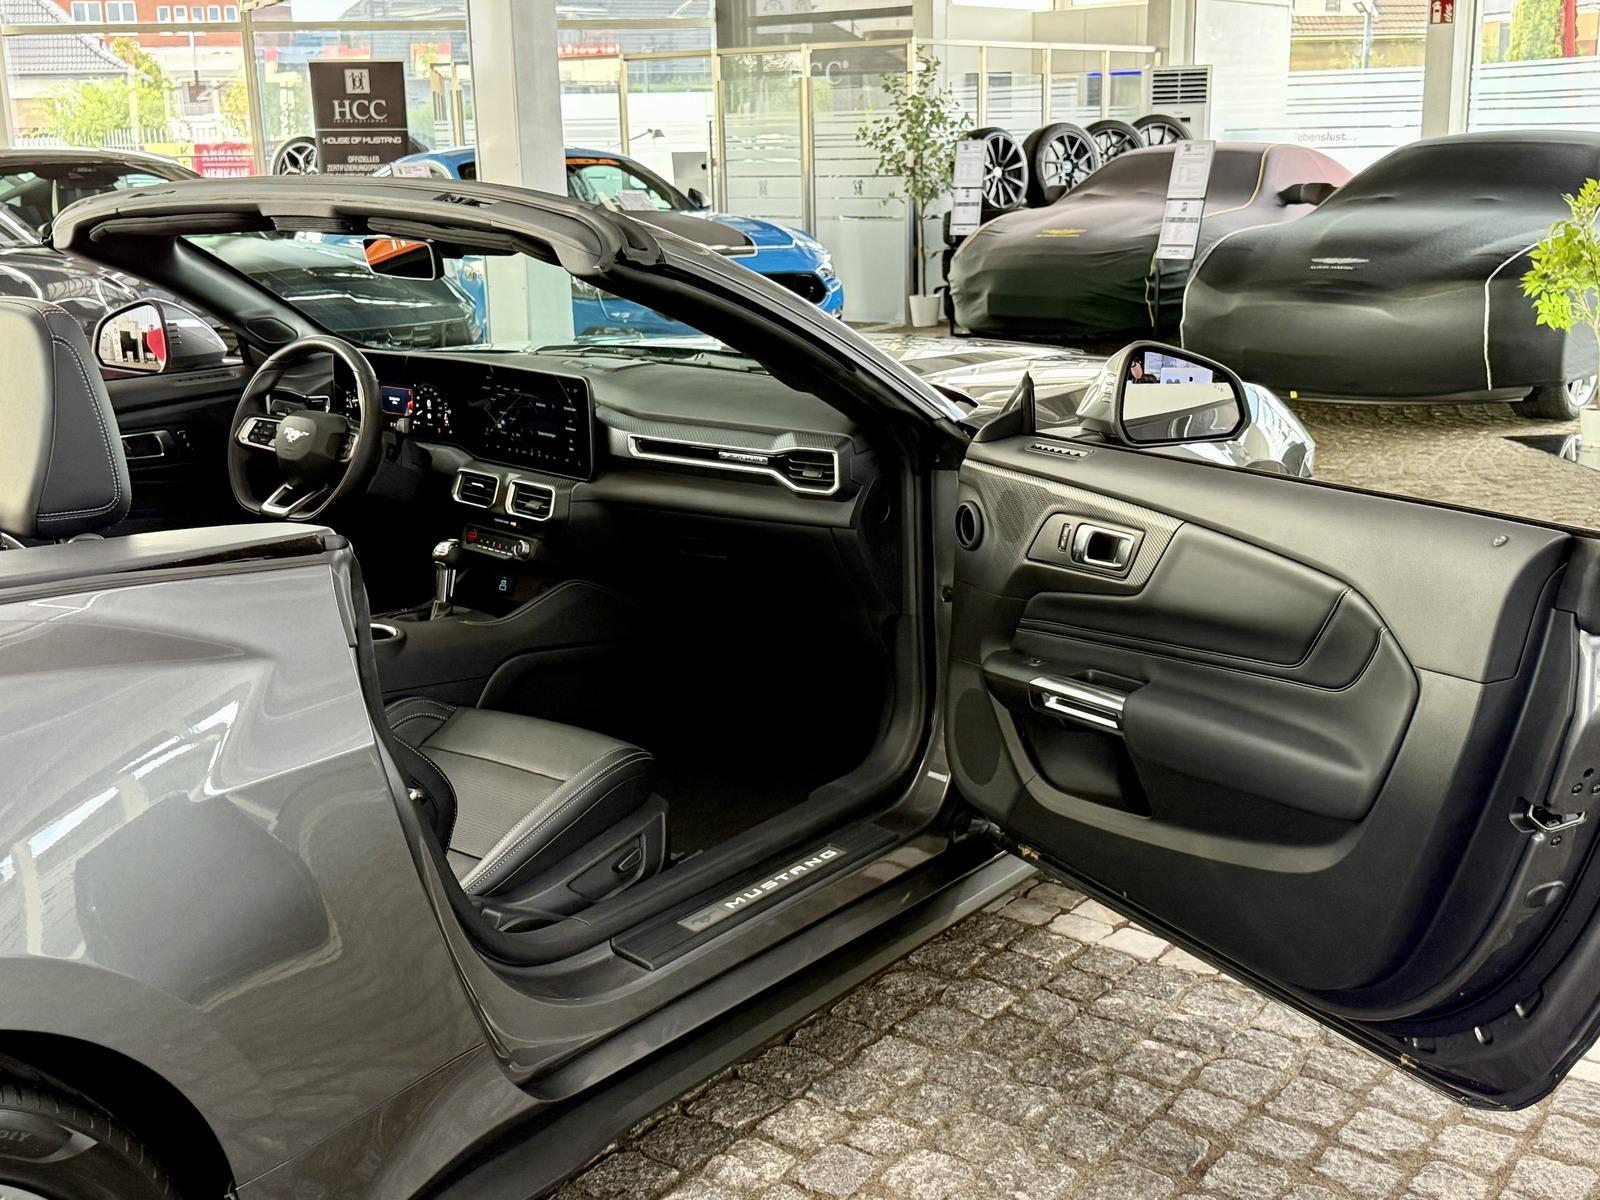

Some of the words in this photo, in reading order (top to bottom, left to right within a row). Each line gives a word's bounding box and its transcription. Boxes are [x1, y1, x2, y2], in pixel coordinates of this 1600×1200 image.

[332, 99, 388, 121] HCC
[322, 136, 350, 145] HOUSE
[351, 136, 362, 145] OF
[362, 136, 402, 145] MUSTANG
[724, 849, 838, 909] MUSTANG
